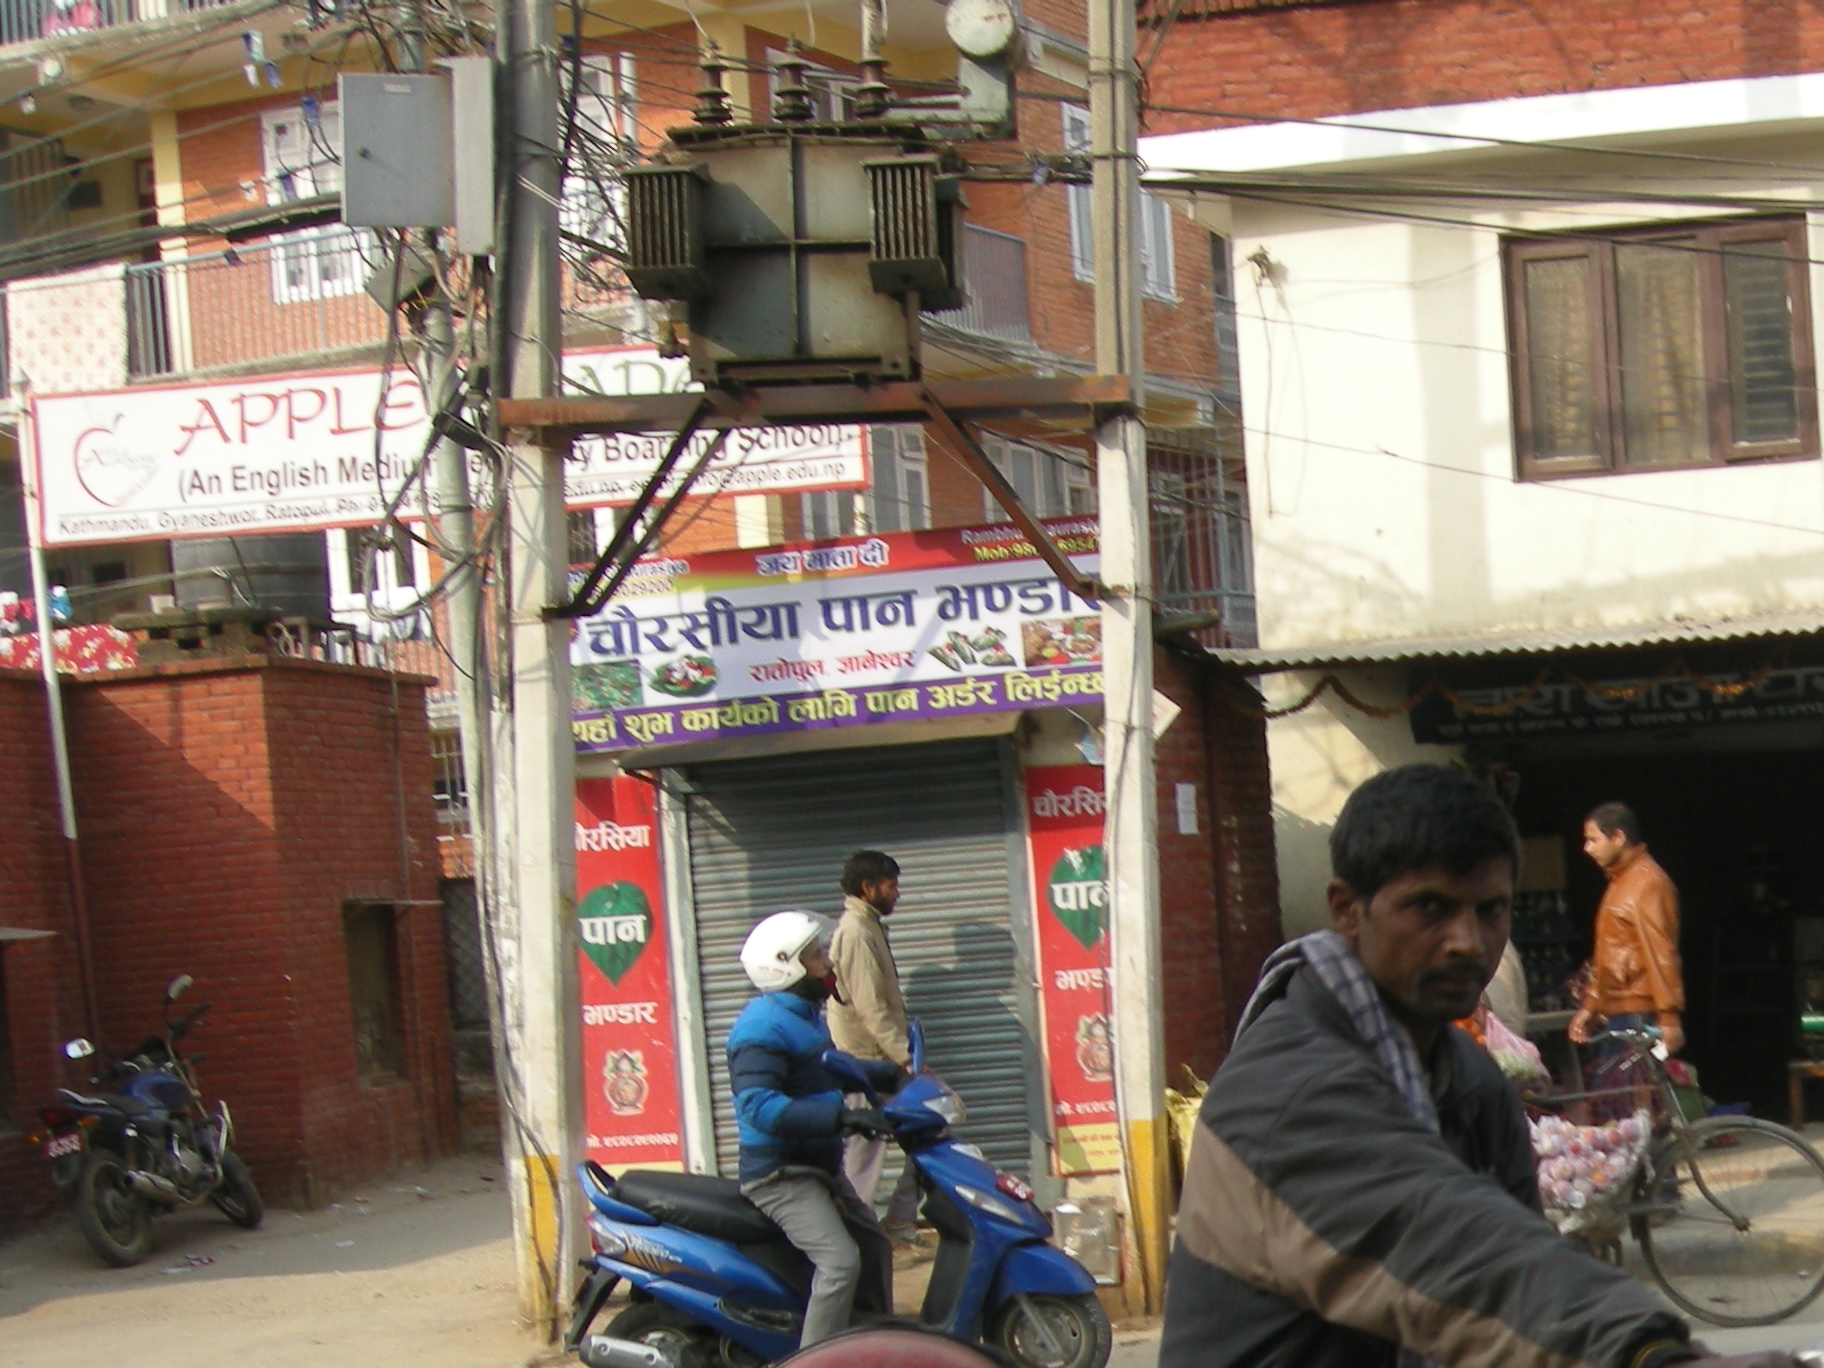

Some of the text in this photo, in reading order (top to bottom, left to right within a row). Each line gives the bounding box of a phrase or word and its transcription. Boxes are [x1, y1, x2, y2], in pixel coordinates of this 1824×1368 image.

[174, 380, 427, 456] APPLE
[233, 461, 331, 498] English
[803, 543, 858, 570] माता
[859, 539, 890, 568] दी
[587, 596, 804, 655] चौरसीया
[819, 589, 919, 632] पान
[624, 708, 674, 743] शुभ
[681, 696, 779, 732] कार्यको
[788, 688, 858, 722] लागि
[865, 687, 920, 714] पान
[928, 675, 997, 710] अर्डर
[1033, 785, 1107, 819] चौरसि
[579, 914, 648, 945] पान
[583, 1001, 658, 1027] भण्डार
